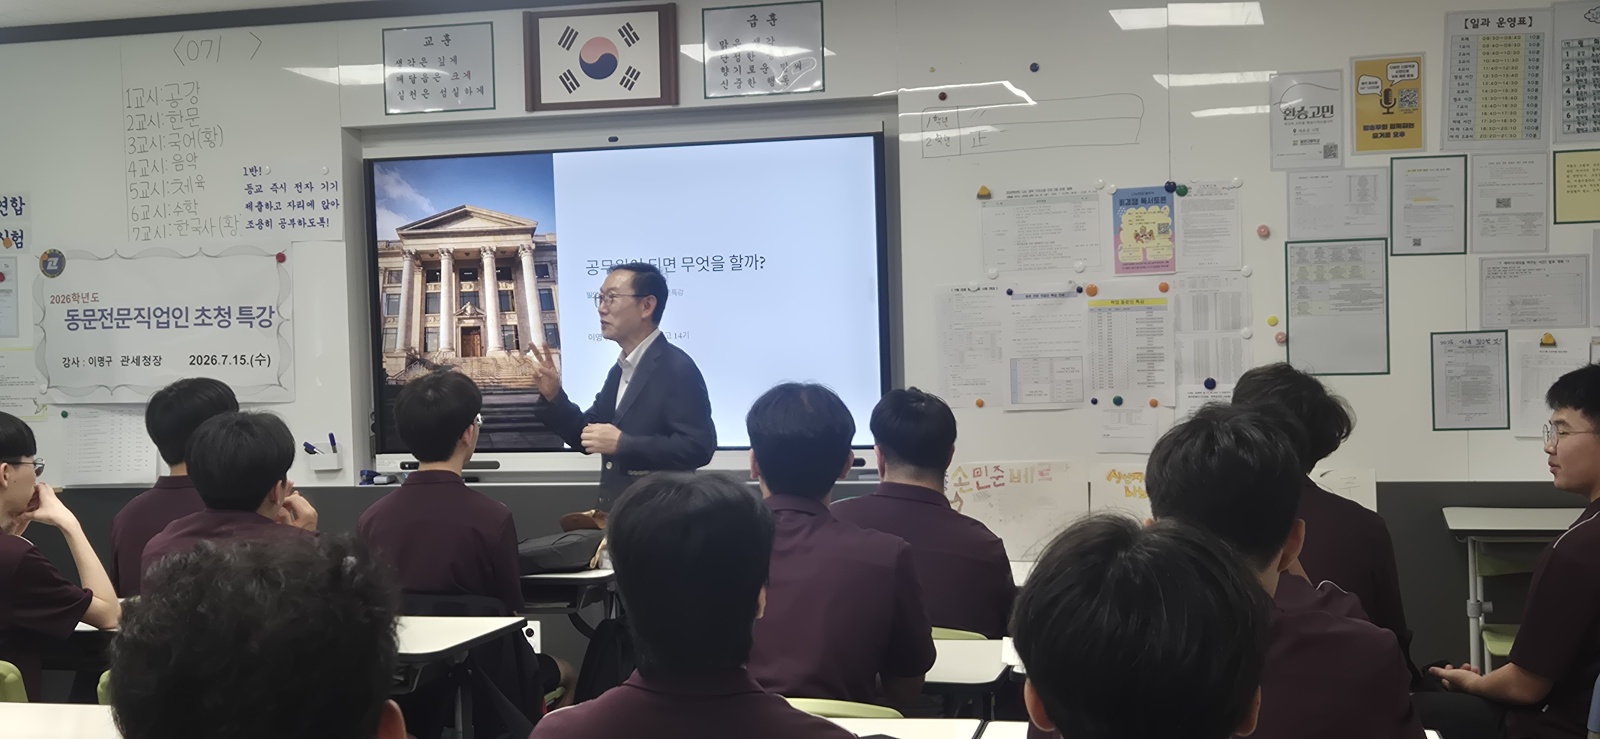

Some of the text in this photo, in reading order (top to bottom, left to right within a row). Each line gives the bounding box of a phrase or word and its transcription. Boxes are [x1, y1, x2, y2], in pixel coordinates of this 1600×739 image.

[396, 57, 428, 68] 생각은
[451, 70, 471, 80] 크게
[720, 63, 768, 76] 향기로운
[721, 77, 756, 90] 신중한
[397, 85, 484, 100] 실천은 성실하게
[1284, 104, 1334, 120] 환승고민
[243, 165, 262, 177] 1반!
[244, 180, 338, 195] 등교 즉시 전자 기기
[245, 201, 282, 212] 제출하고
[287, 199, 314, 210] 자리에
[245, 217, 329, 230] 조용히 공부하도록!
[681, 255, 725, 272] 무엇을
[729, 254, 766, 271] 할까?
[50, 292, 100, 304] 2026학년도
[64, 306, 275, 331] 동문전문직업인 초청 특강
[62, 357, 80, 368] 강사
[88, 356, 112, 367] 이명구
[120, 355, 162, 366] 관세청장
[189, 353, 271, 368] 2026.7.15.(수)
